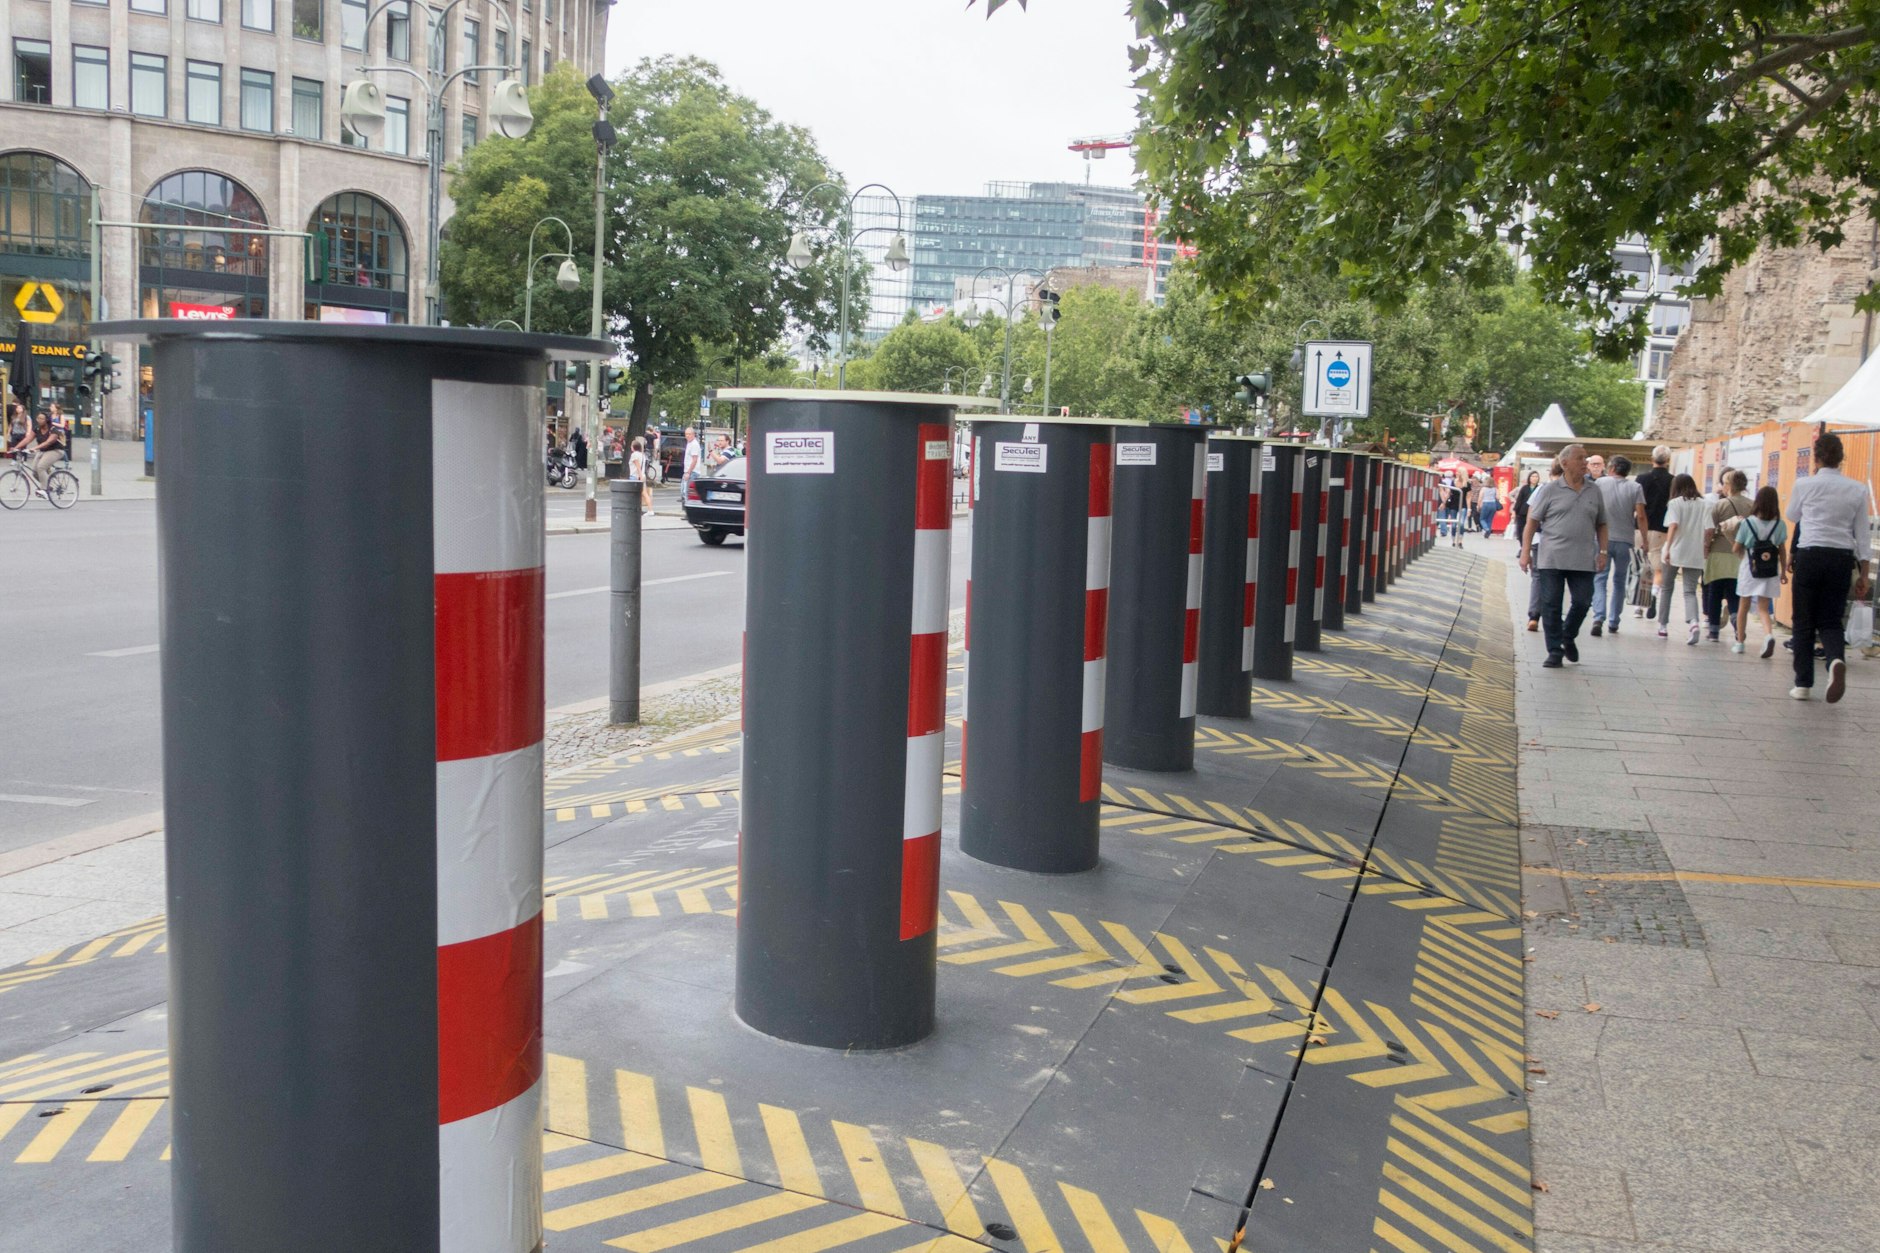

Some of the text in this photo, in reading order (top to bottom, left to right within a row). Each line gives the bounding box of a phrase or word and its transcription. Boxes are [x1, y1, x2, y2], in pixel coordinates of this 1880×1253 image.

[0, 342, 71, 357] MZBANK
[774, 437, 822, 449] SecuTec
[1002, 446, 1039, 455] SecuTec
[1122, 445, 1150, 453] SecuTec
